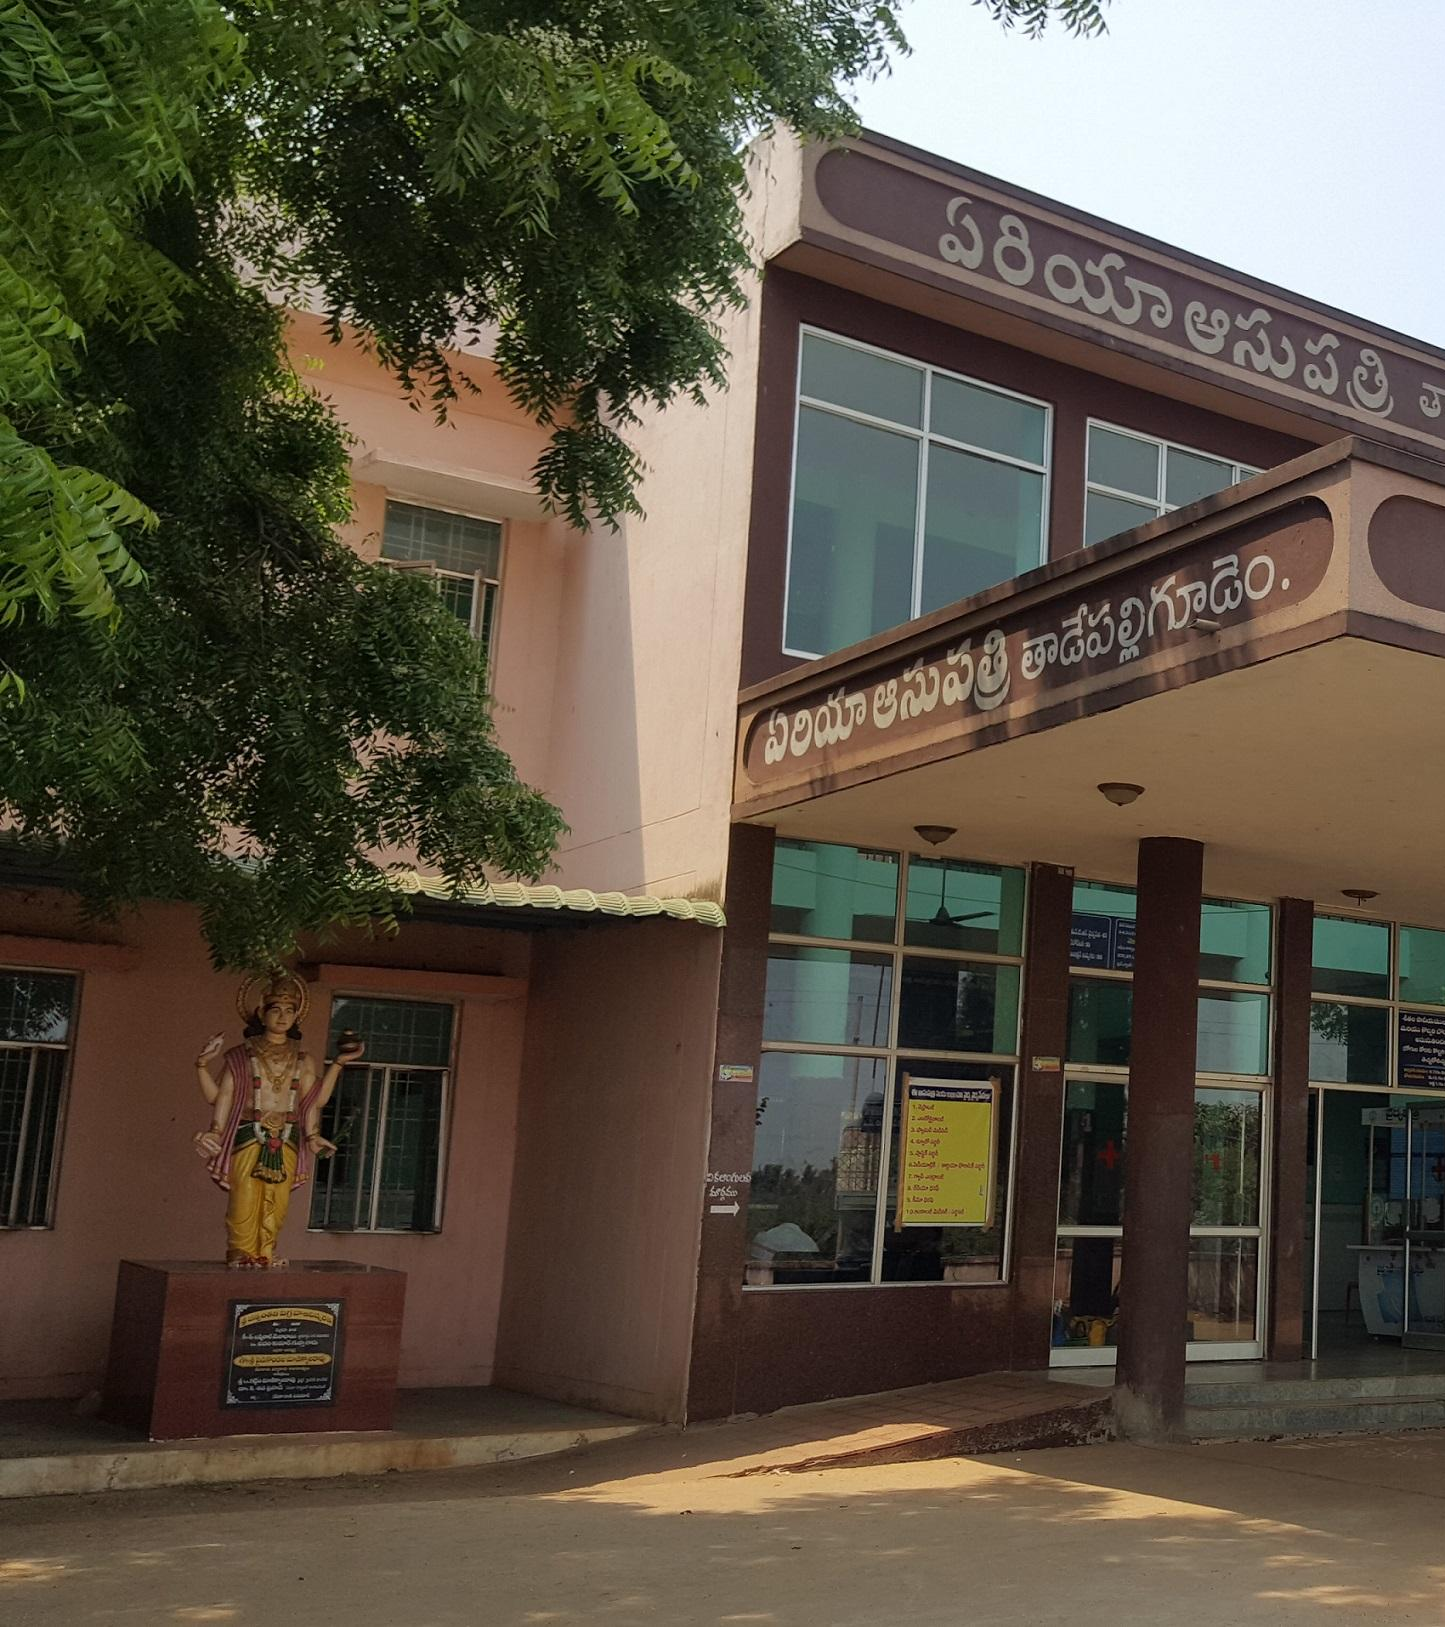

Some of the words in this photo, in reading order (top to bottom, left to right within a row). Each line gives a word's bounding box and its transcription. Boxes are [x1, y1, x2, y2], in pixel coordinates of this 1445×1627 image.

[938, 197, 1173, 330] ఏరియా
[1183, 300, 1396, 418] ఆసుపత్రి
[764, 690, 868, 765] ఏరియా
[872, 629, 1012, 710] ఆసుపత్రి
